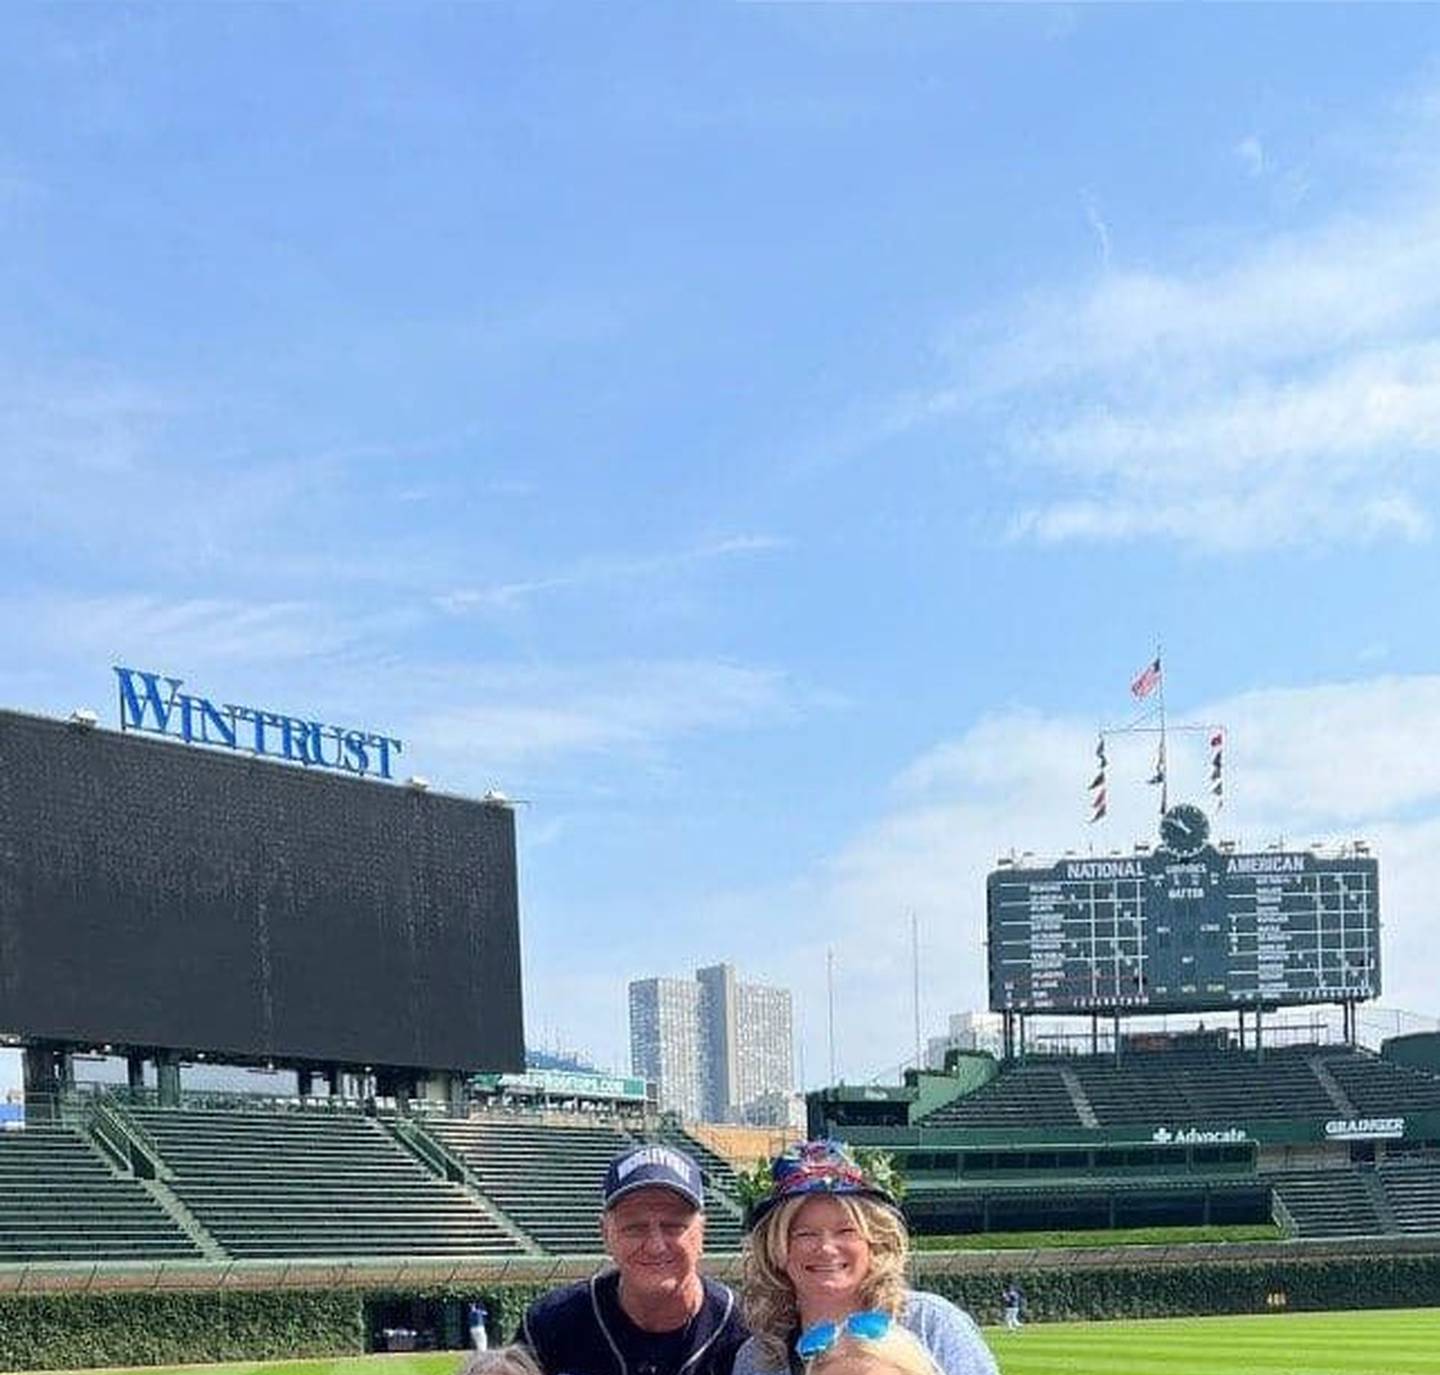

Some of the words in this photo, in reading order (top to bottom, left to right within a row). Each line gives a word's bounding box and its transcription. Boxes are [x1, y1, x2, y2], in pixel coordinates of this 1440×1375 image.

[113, 666, 402, 778] WINTRUST
[1066, 861, 1145, 878] NATIONAL
[1227, 856, 1305, 873] AMERICAN
[1175, 1128, 1246, 1144] Advocate
